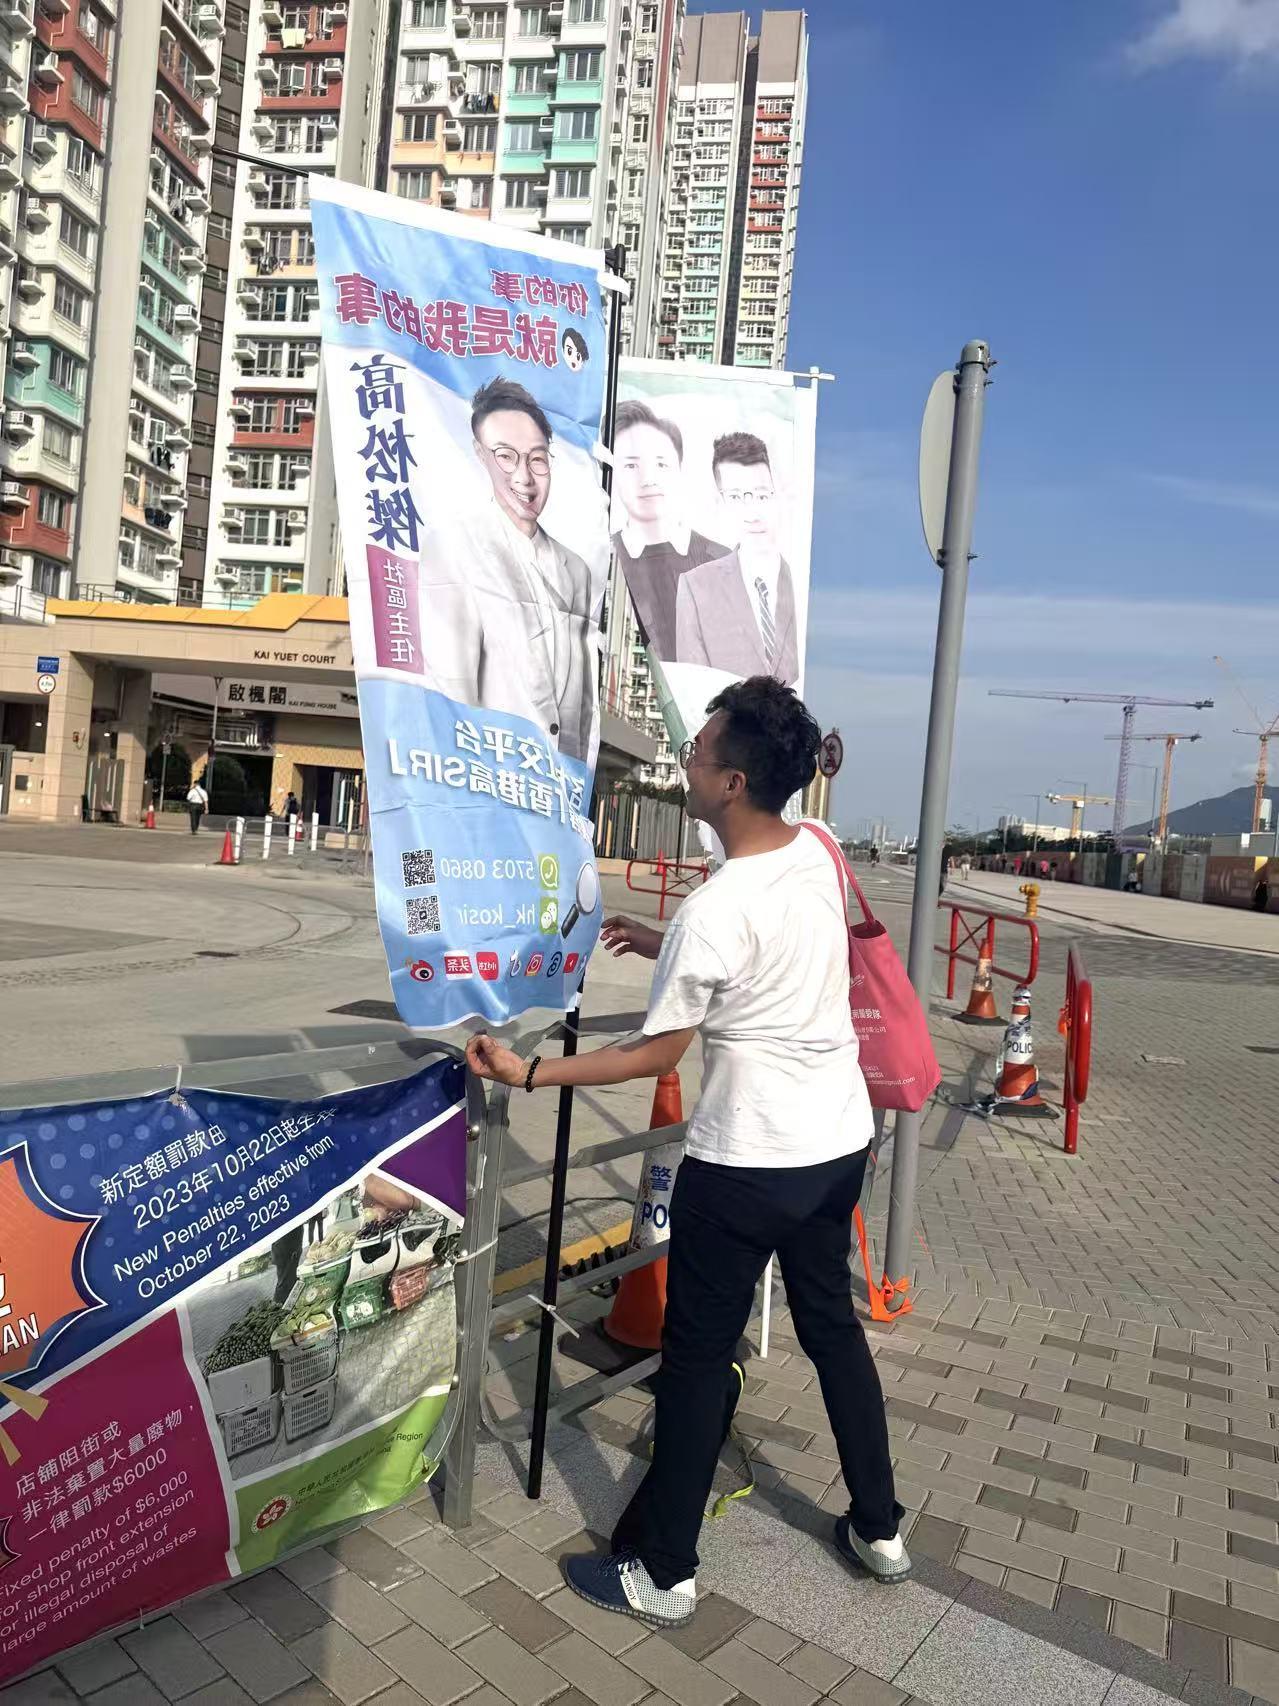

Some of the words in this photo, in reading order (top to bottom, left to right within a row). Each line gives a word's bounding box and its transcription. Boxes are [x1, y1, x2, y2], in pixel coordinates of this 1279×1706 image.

[254, 650, 270, 660] KAI
[273, 652, 298, 662] YUET
[302, 654, 336, 664] COURT
[1007, 1040, 1033, 1054] POLIC
[98, 1124, 226, 1205] 新定額罰款由
[650, 1165, 672, 1192] 警
[114, 1244, 159, 1282] New
[162, 1195, 245, 1252] Penalties
[249, 1152, 310, 1202] effective
[305, 1135, 335, 1161] from
[138, 1242, 213, 1298] October
[217, 1225, 247, 1251] 22,
[248, 1194, 290, 1231] 2023
[1, 1312, 40, 1356] AN
[16, 1420, 122, 1499] 店舖阻街或
[396, 1432, 424, 1443] Region
[28, 1448, 168, 1541] 一律罰款$6000
[48, 1524, 110, 1572] penalty
[115, 1507, 132, 1526] of
[135, 1471, 188, 1513] $6,000
[0, 1620, 19, 1637] or
[24, 1585, 75, 1623] illegal
[80, 1541, 149, 1588] disposal
[153, 1523, 169, 1542] of
[27, 1570, 72, 1602] shop
[75, 1539, 116, 1571] front
[120, 1489, 195, 1544] extension
[2, 1621, 48, 1653] large
[52, 1575, 117, 1623] amount
[121, 1561, 138, 1579] of
[142, 1527, 197, 1566] wastes
